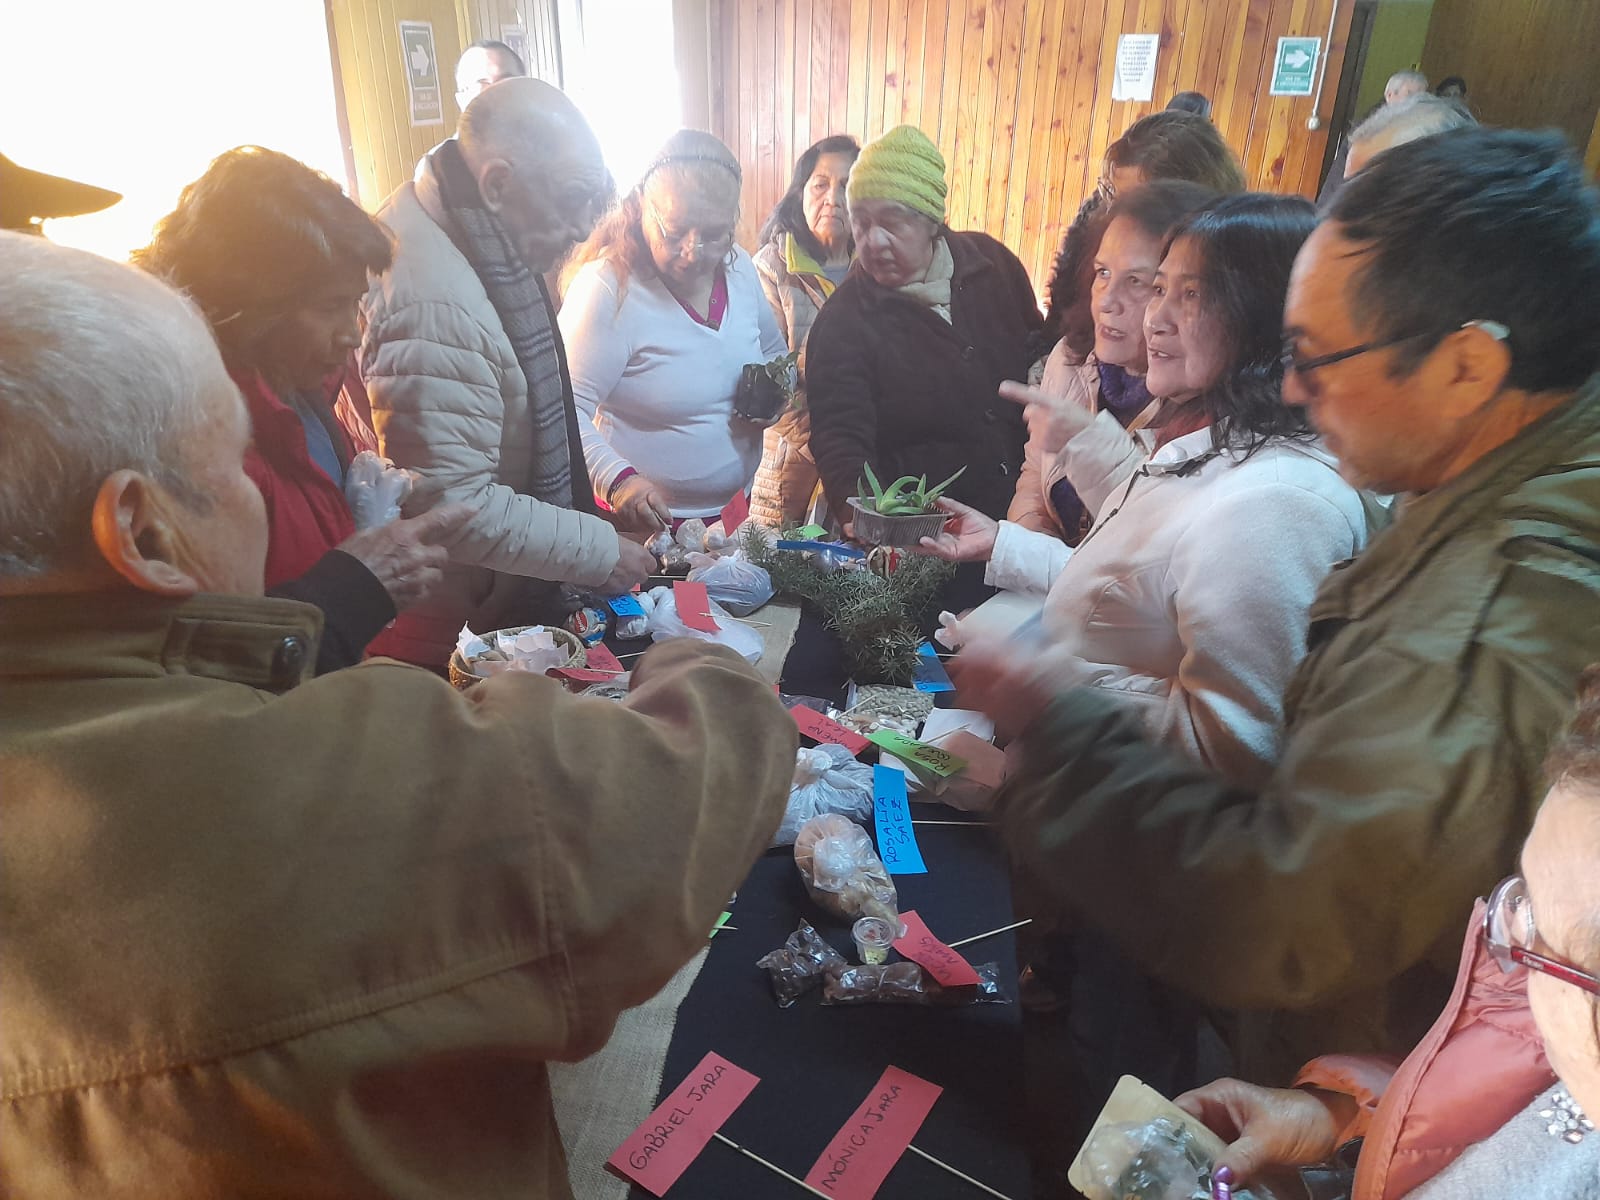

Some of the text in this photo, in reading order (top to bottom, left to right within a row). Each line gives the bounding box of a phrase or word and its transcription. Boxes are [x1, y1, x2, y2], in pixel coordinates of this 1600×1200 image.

[914, 751, 950, 771] ROSA
[879, 796, 900, 864] ROSALÍA
[629, 1065, 727, 1170] GABRIEL JARA
[821, 1085, 902, 1190] MÓNICA JARA
